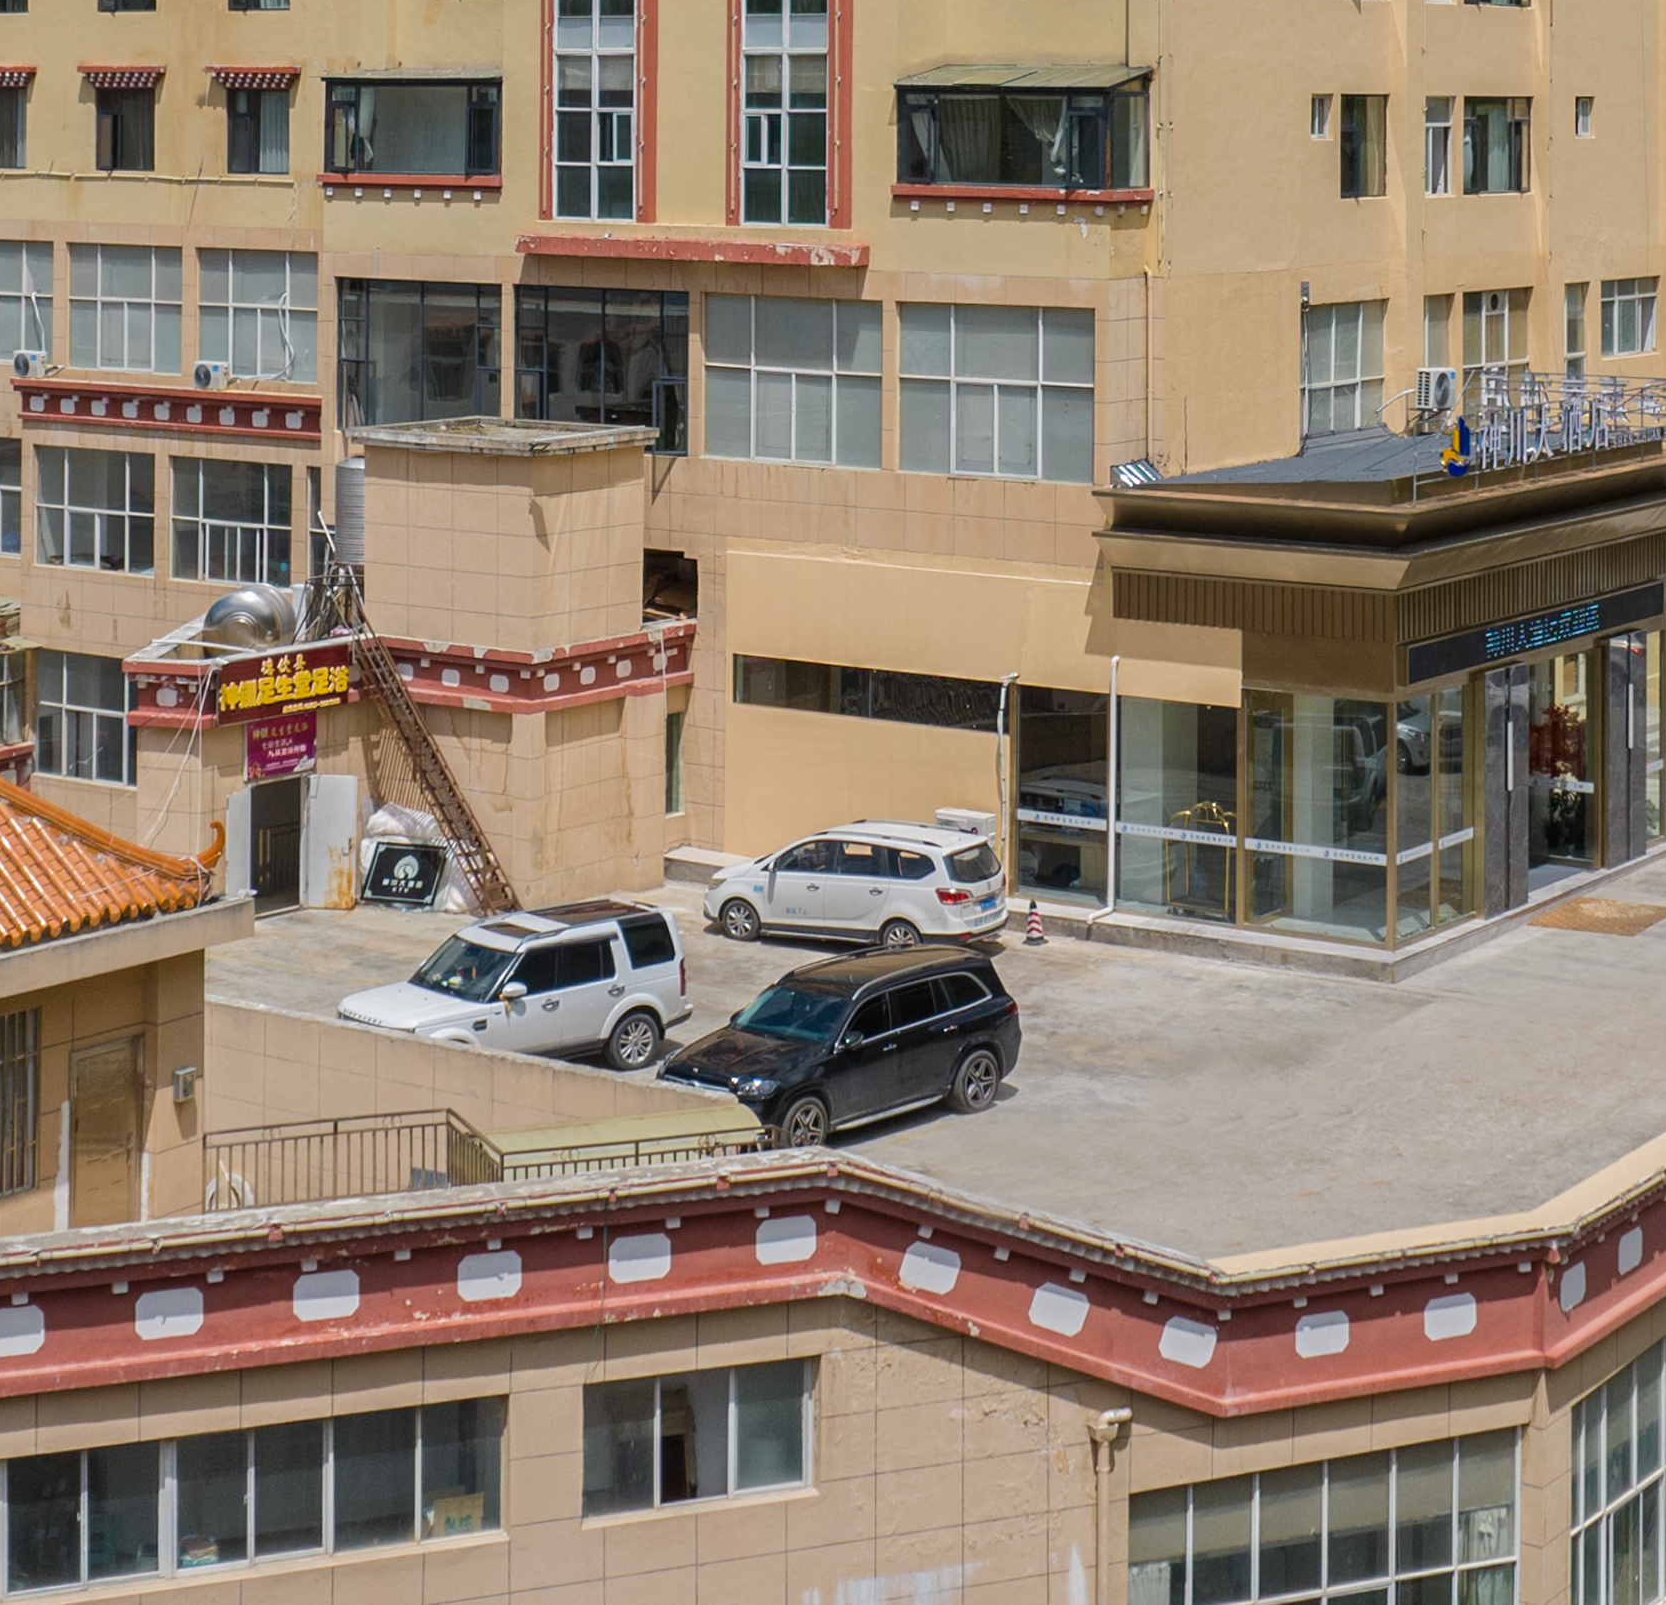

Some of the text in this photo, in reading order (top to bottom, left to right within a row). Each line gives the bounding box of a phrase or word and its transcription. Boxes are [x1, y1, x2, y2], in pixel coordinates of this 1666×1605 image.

[1480, 400, 1609, 470] 神川大酒店
